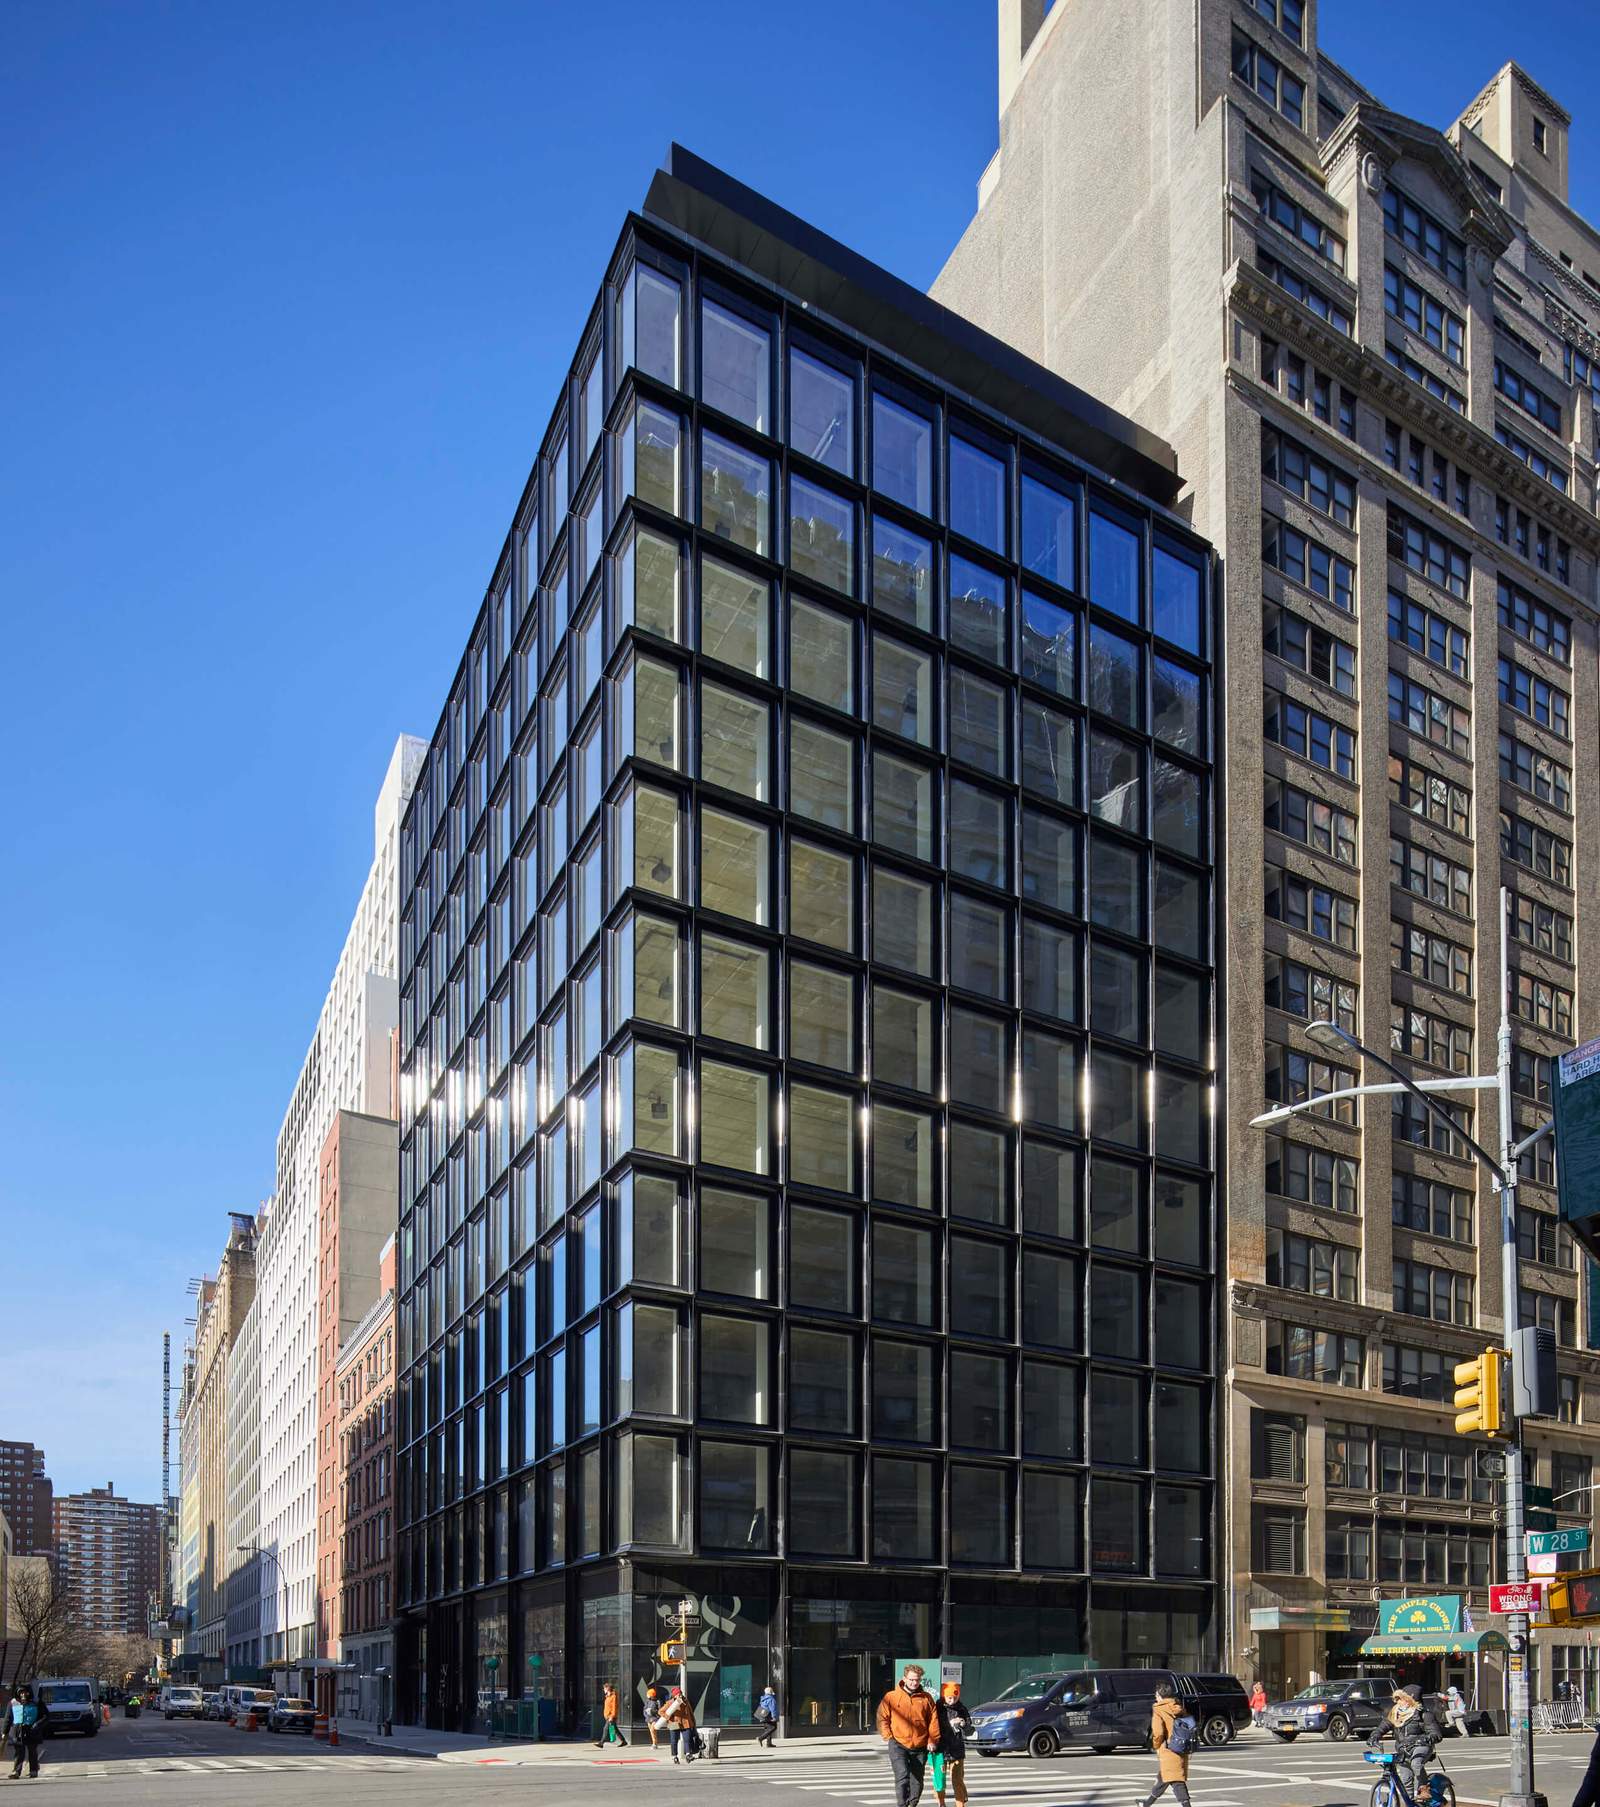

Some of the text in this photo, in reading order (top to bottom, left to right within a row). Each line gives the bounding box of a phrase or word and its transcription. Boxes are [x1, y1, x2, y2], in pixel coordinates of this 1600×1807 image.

[1566, 1042, 1600, 1063] DANGE
[1562, 1059, 1591, 1077] HARD
[1484, 1458, 1501, 1472] ONE
[1533, 1531, 1584, 1552] W 28 ST
[1499, 1594, 1532, 1602] WRONG
[1388, 1599, 1451, 1633] THE TRIPLE CROWN
[1417, 1645, 1447, 1653] CROWN
